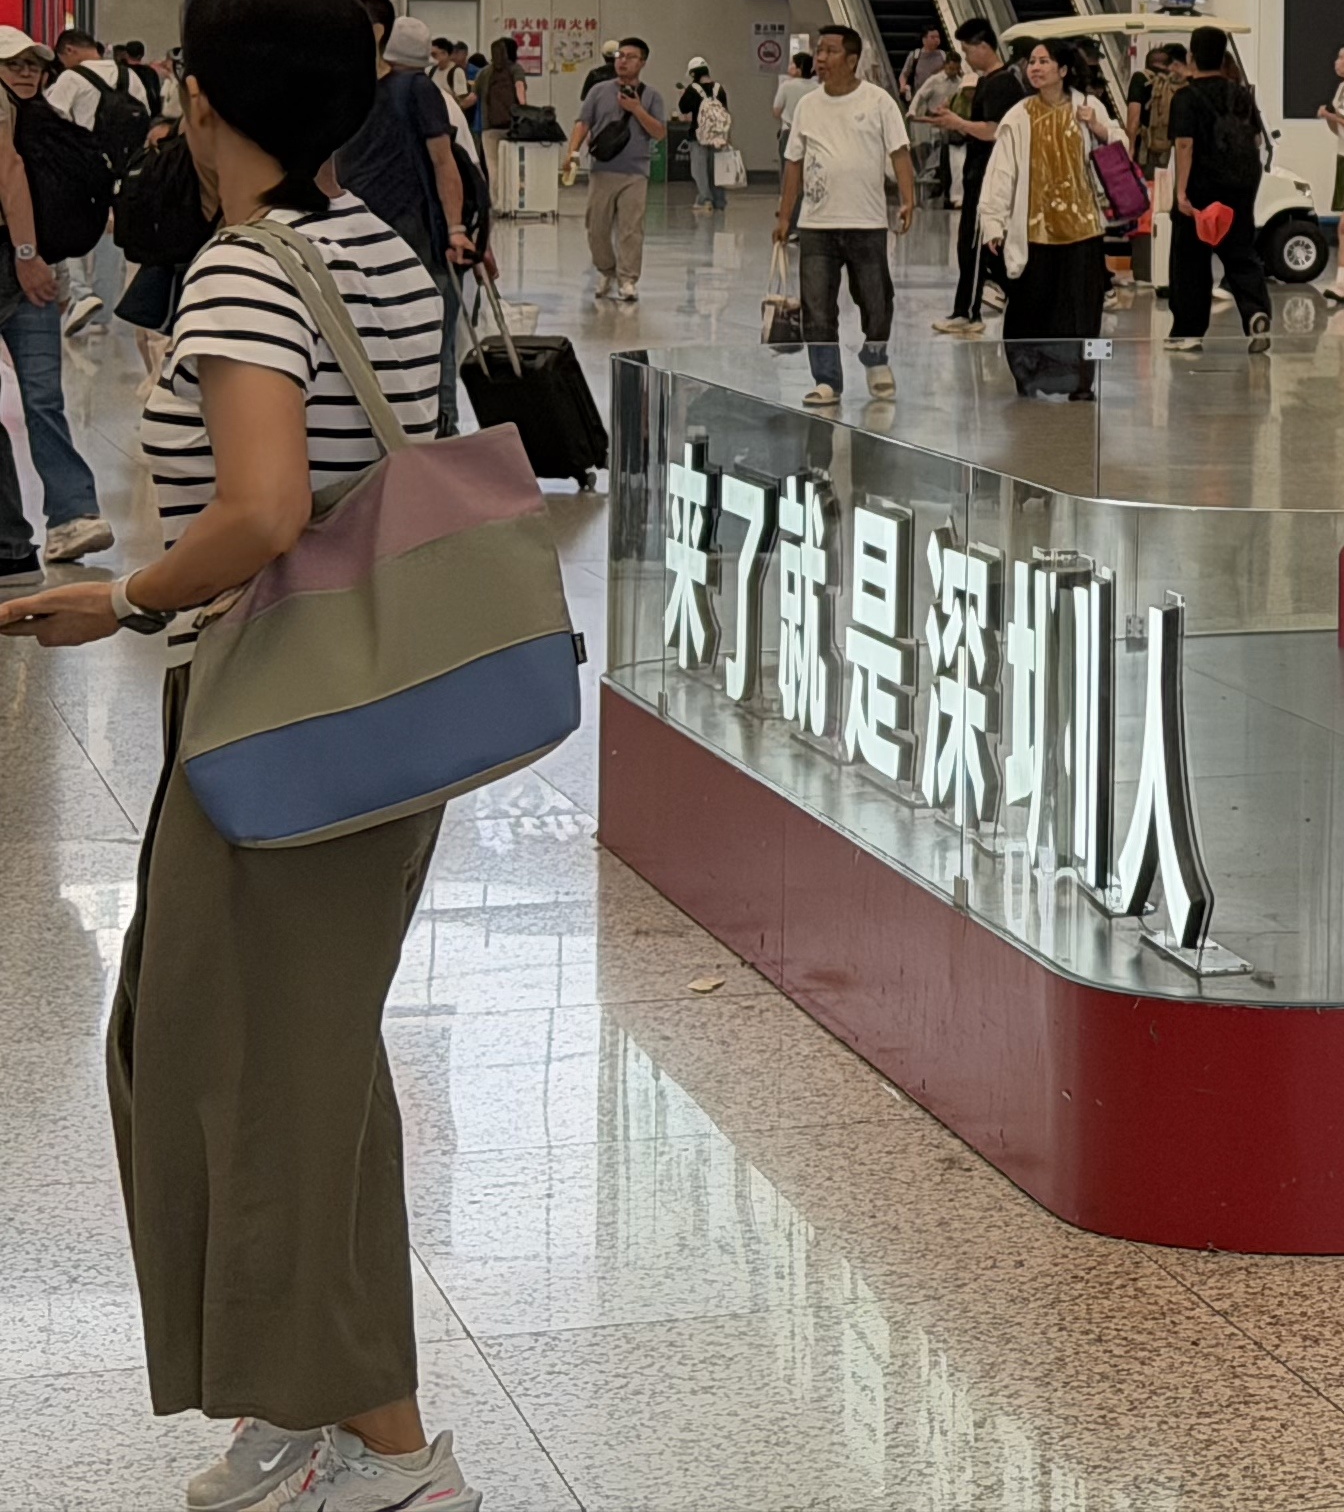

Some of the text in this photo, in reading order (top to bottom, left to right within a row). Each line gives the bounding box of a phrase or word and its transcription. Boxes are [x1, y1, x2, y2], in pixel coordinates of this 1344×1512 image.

[664, 438, 1214, 950] 来了就是深圳人
